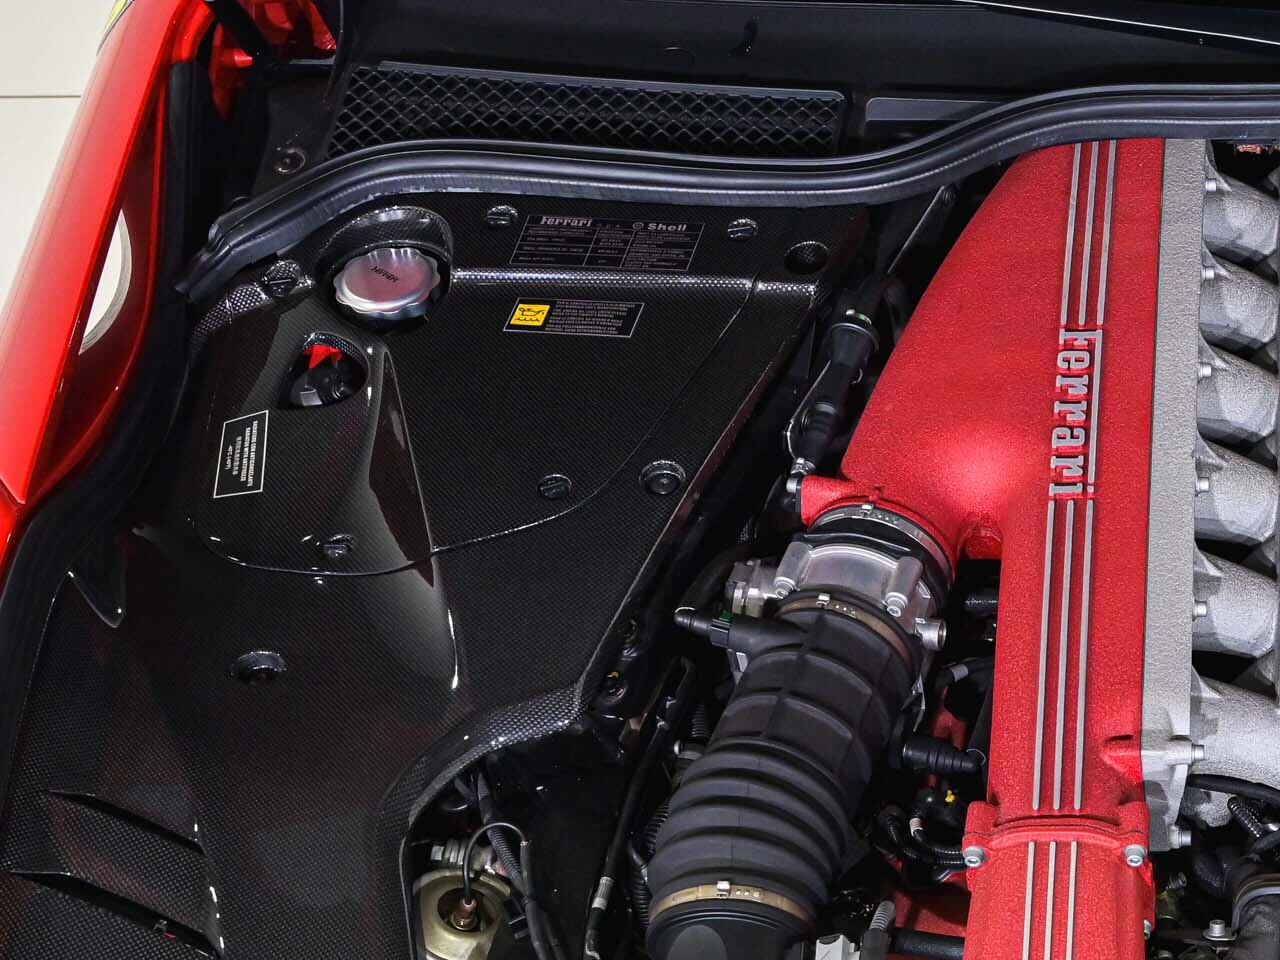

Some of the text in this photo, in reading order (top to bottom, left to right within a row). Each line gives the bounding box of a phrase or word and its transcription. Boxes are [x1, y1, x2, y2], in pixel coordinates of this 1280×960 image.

[540, 216, 592, 227] Ferrari
[647, 223, 687, 231] Shell
[1049, 329, 1103, 498] Ferrari
